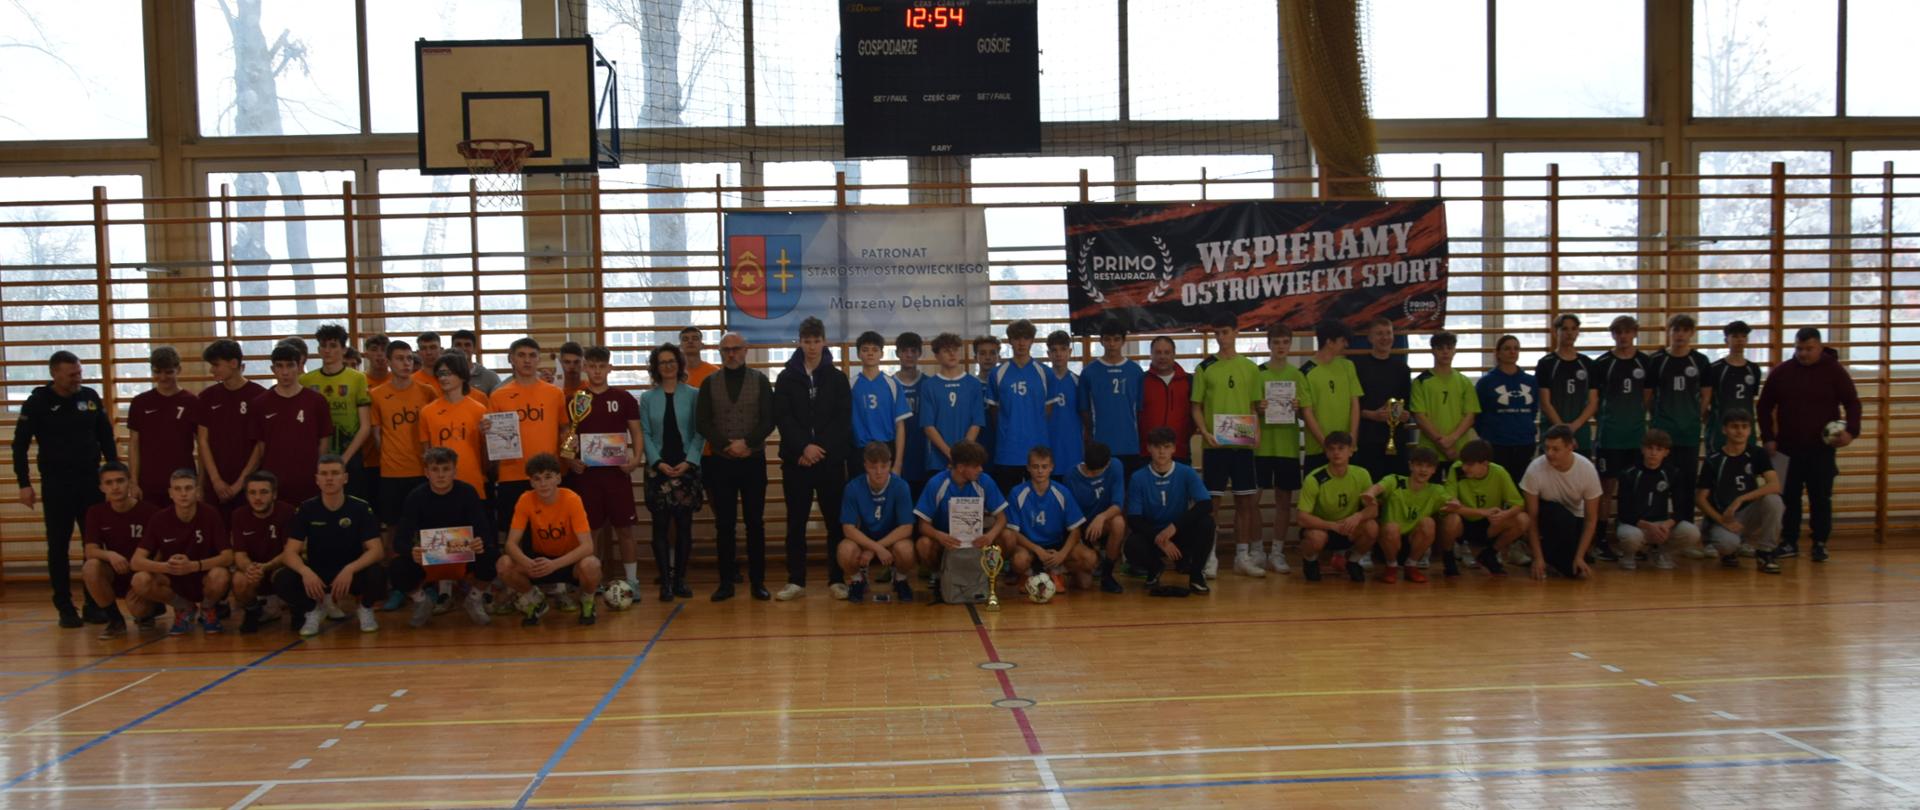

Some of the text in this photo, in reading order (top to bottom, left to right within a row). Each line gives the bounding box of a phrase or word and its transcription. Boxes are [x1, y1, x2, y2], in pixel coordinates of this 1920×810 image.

[906, 7, 963, 28] 12:54
[858, 39, 918, 56] GOSPODARZE
[977, 34, 1011, 53] GOŚCIE
[861, 248, 927, 259] PATRONAT
[1196, 222, 1413, 274] WSPIERAMY
[807, 263, 984, 277] STAROSTY OSTROWIECKIEGO
[1093, 255, 1156, 271] PRIMO
[1094, 272, 1156, 280] RESTAURACJA
[1181, 257, 1442, 307] OSTROWIECKI SPORT
[830, 294, 965, 312] Marzeny Dębniak
[1011, 381, 1027, 396] 15
[1228, 375, 1234, 389] 6
[1328, 380, 1335, 394] 9
[1567, 379, 1575, 394] 6
[1622, 378, 1631, 393] 9
[1674, 376, 1685, 391] 10
[1441, 391, 1448, 404] 7
[1736, 384, 1745, 399] 2
[948, 391, 957, 407] 9
[176, 407, 184, 419] 7
[239, 402, 247, 415] 8
[606, 401, 618, 413] 10
[296, 410, 305, 423] 4
[392, 406, 419, 430] pbi
[1736, 476, 1745, 491] 5
[1160, 490, 1167, 506] 1
[1338, 493, 1348, 507] 13
[1476, 494, 1486, 507] 15
[1647, 492, 1653, 506] 1
[874, 505, 882, 520] 4
[1407, 507, 1418, 521] 16
[130, 524, 143, 538] 12
[196, 530, 203, 543] 5
[269, 525, 277, 538] 2
